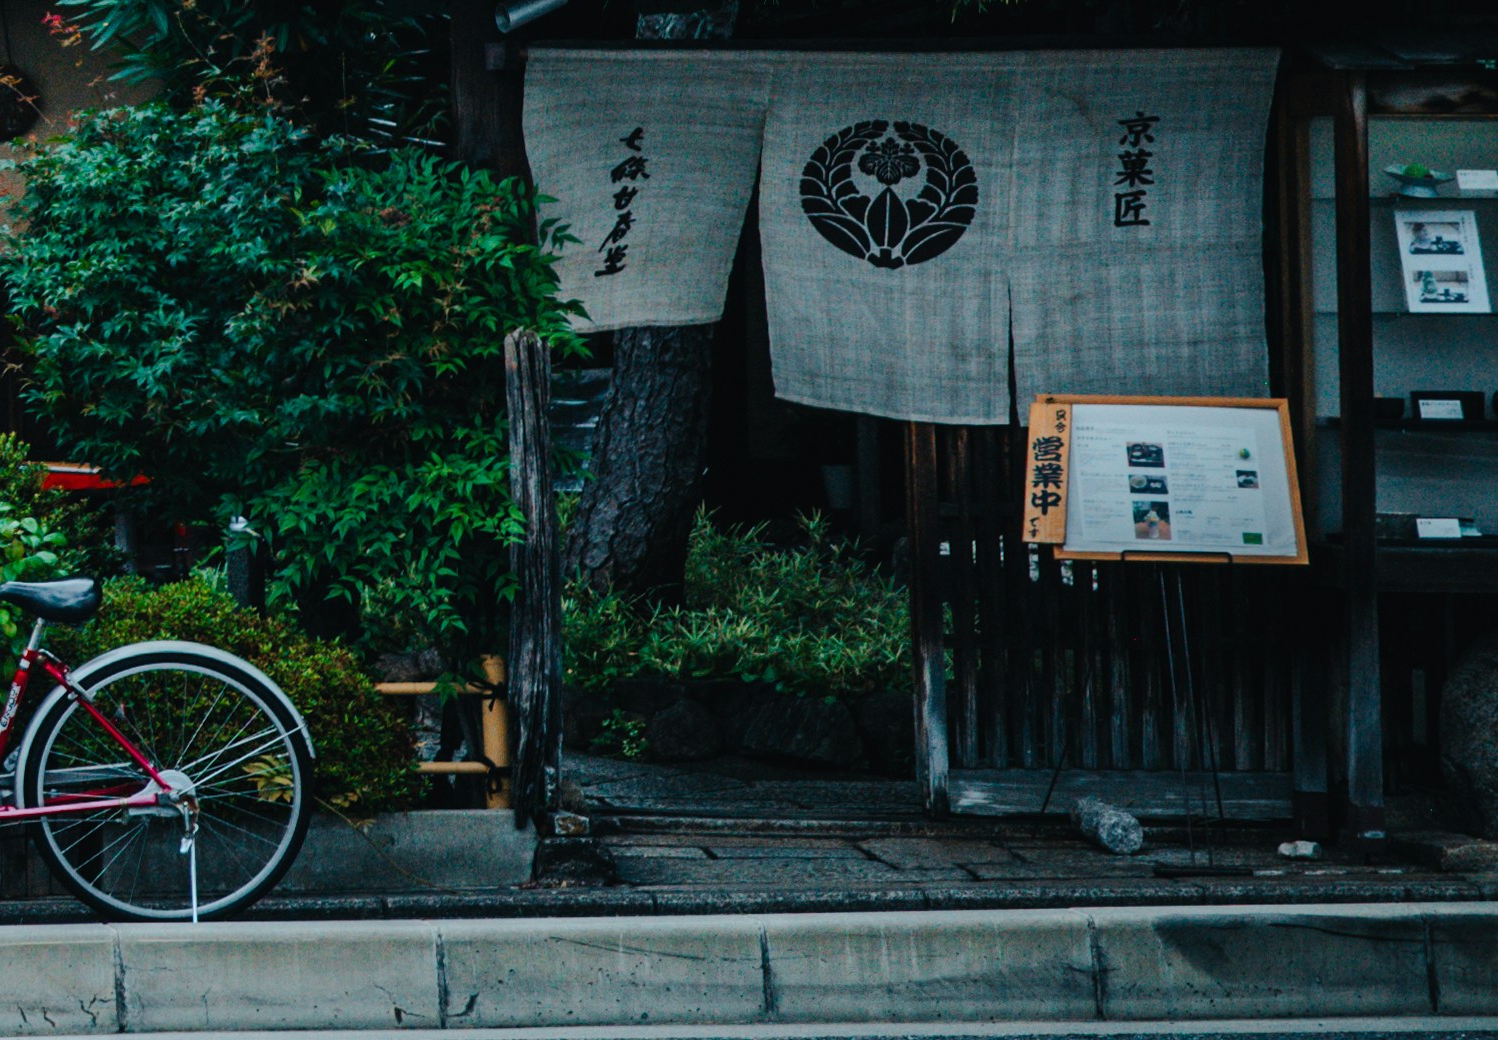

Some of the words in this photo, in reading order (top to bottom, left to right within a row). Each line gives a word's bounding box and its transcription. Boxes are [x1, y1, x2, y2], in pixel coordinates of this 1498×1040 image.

[1113, 111, 1161, 228] 京菓匠
[1031, 435, 1065, 516] 営業中
